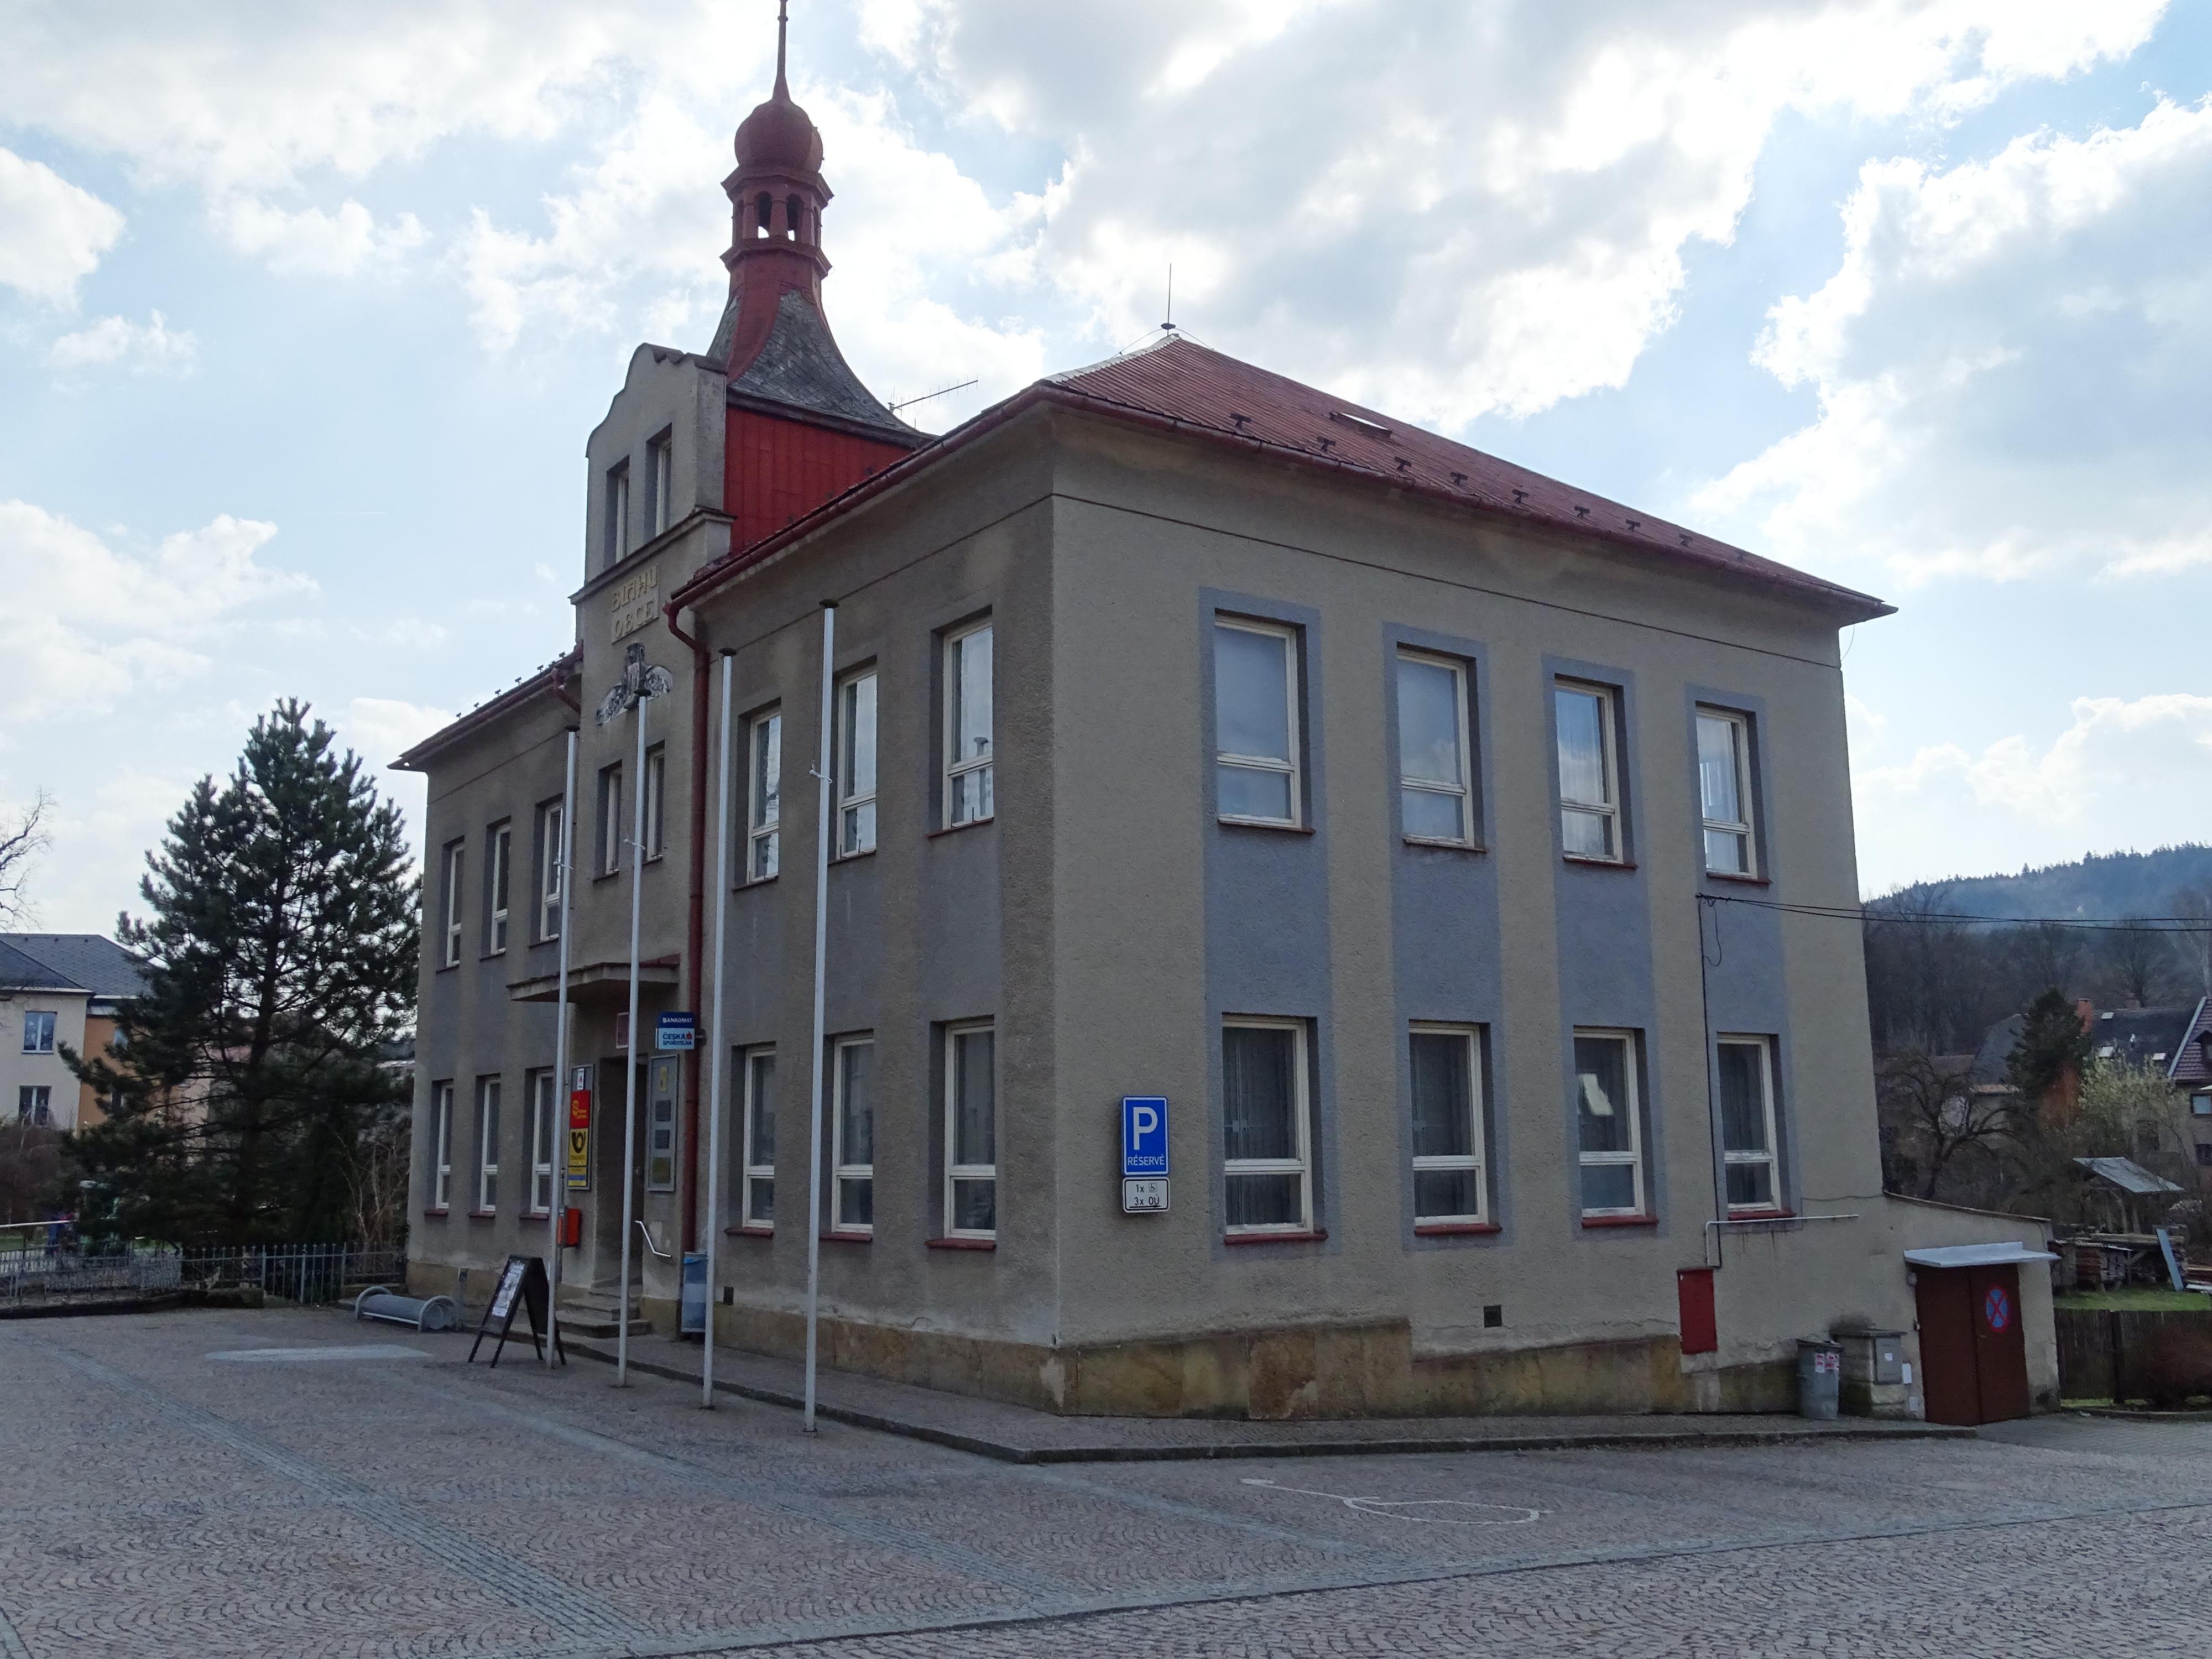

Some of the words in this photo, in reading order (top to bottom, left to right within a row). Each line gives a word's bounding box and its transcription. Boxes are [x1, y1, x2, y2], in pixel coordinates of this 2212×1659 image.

[615, 598, 654, 638] OBCE
[1133, 1107, 1158, 1150] P
[1127, 1154, 1165, 1166] RÉSERVÉ
[1135, 1184, 1145, 1193] 1x
[1134, 1197, 1144, 1206] 3x
